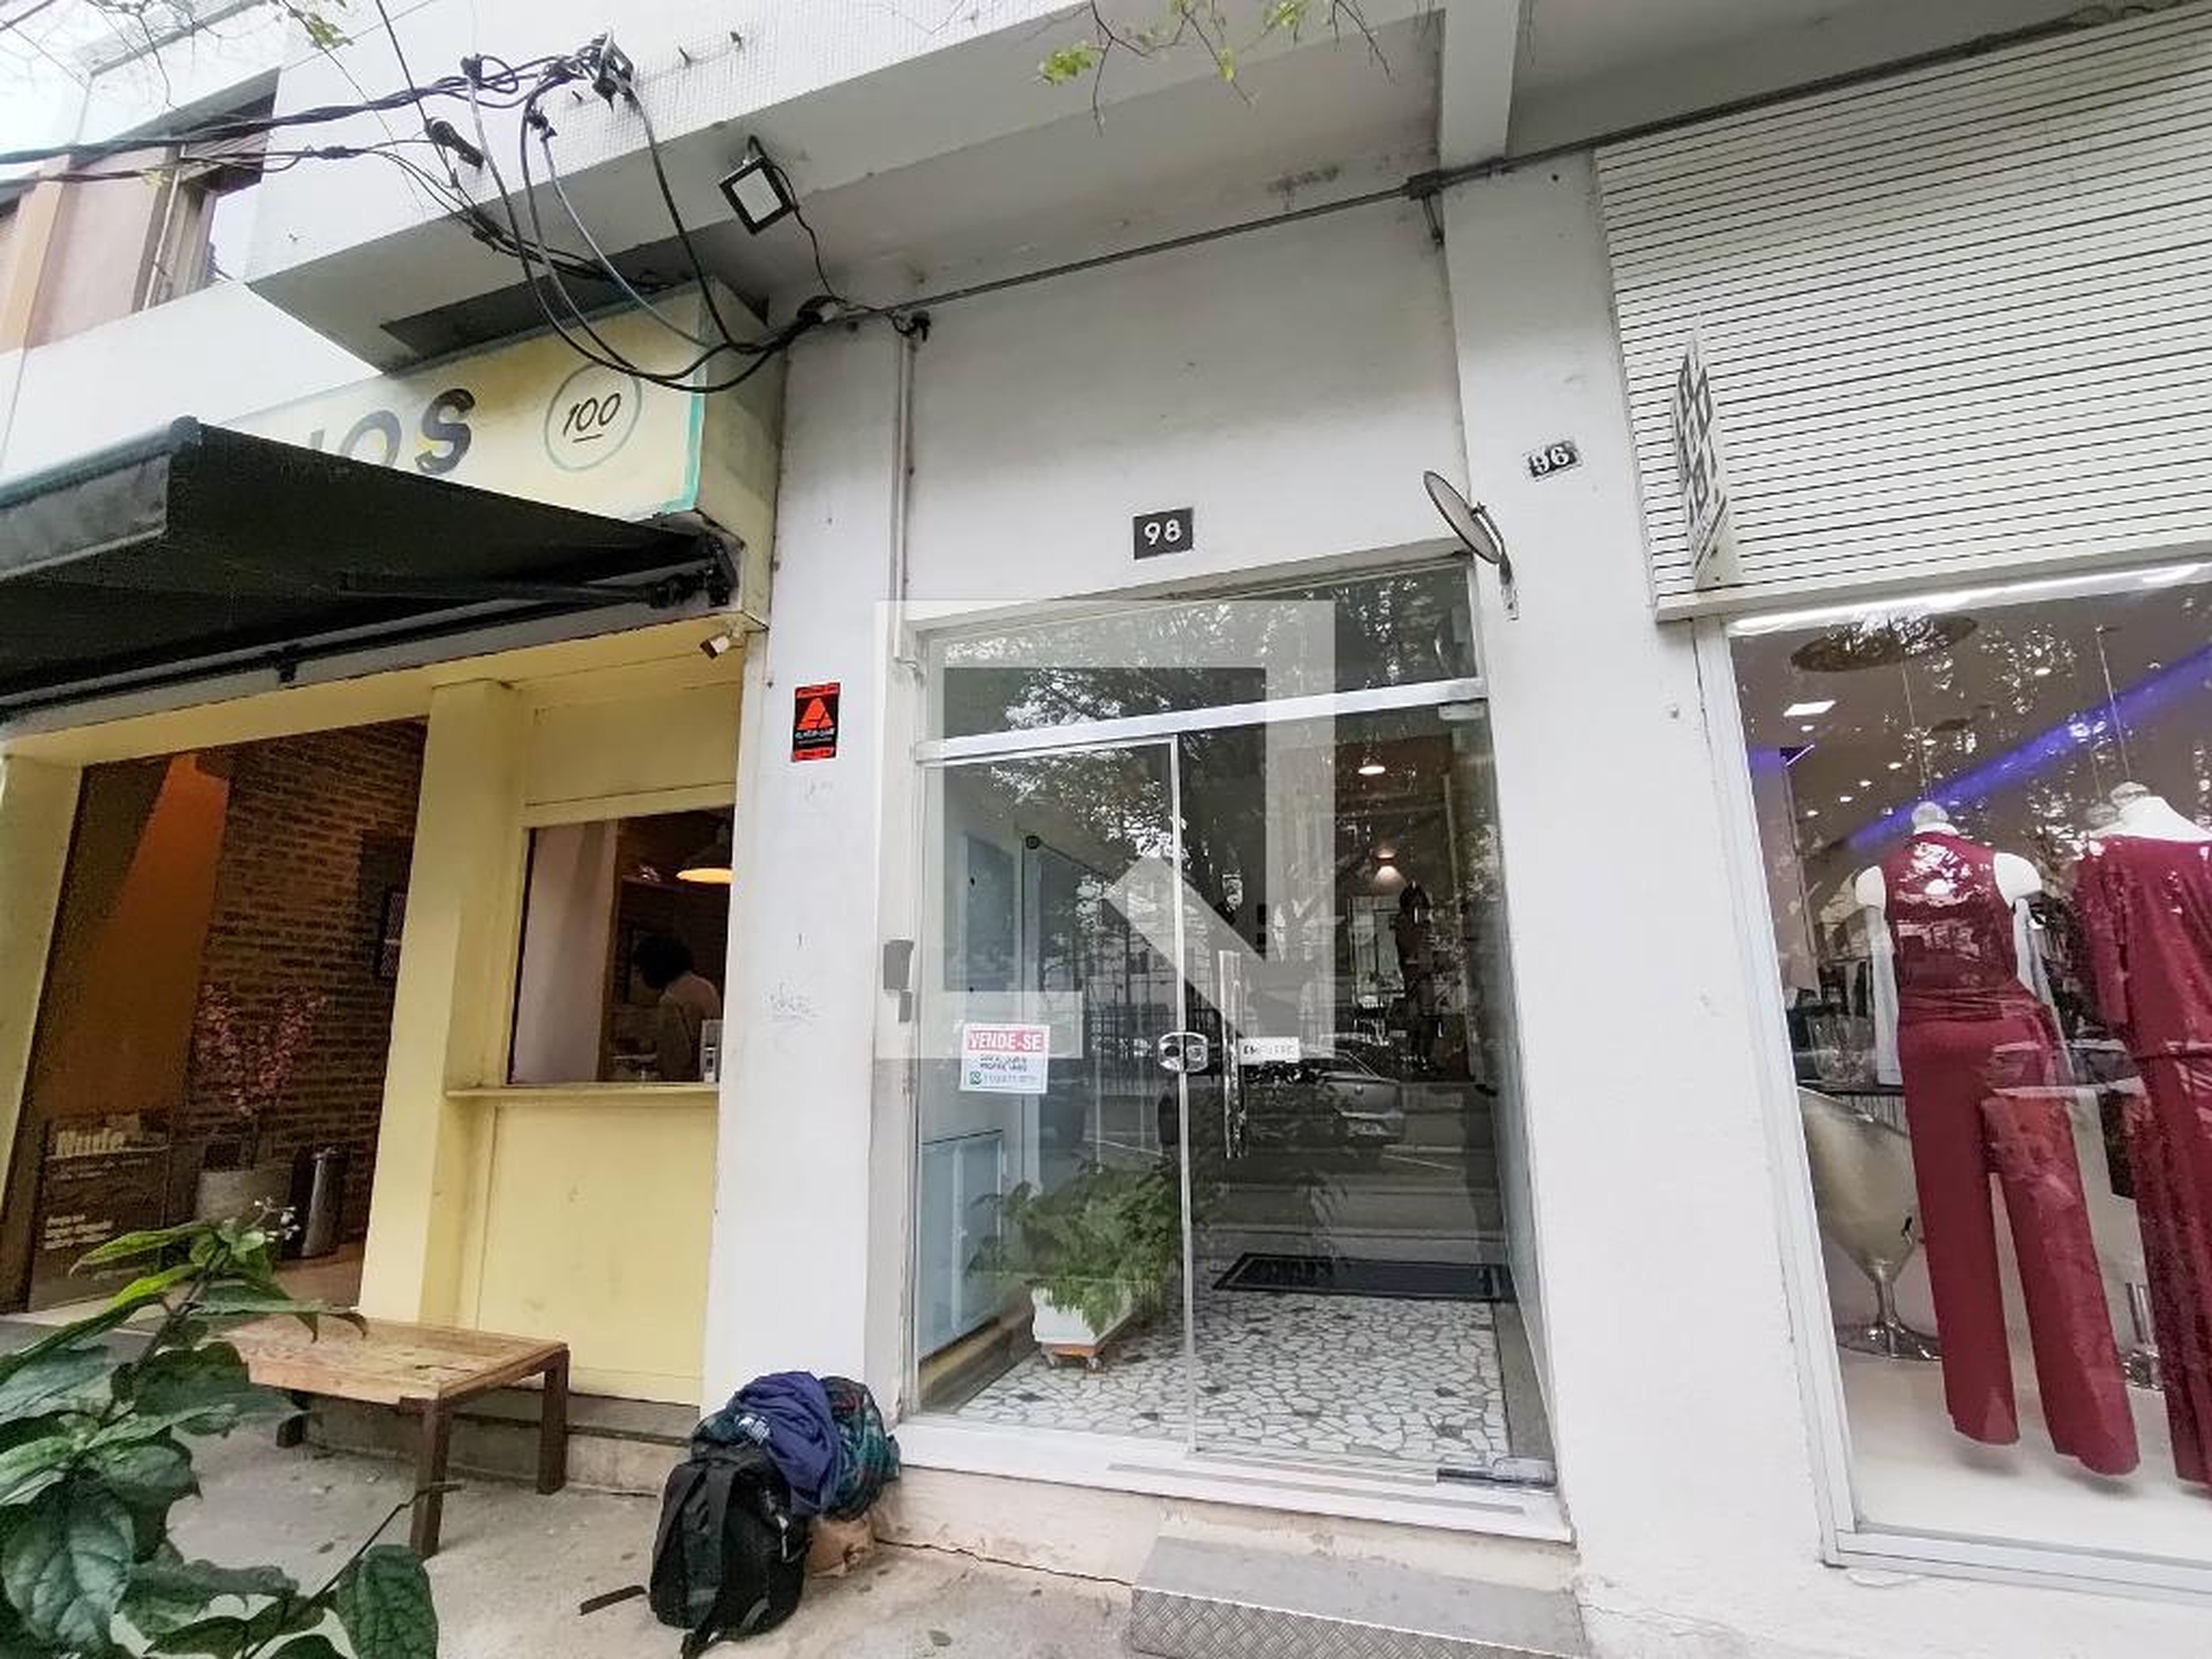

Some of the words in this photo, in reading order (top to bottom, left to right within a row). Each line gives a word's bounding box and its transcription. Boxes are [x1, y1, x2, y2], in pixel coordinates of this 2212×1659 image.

[562, 391, 623, 438] 100
[1144, 518, 1182, 546] 98
[968, 1031, 1042, 1051] VENDE-SE
